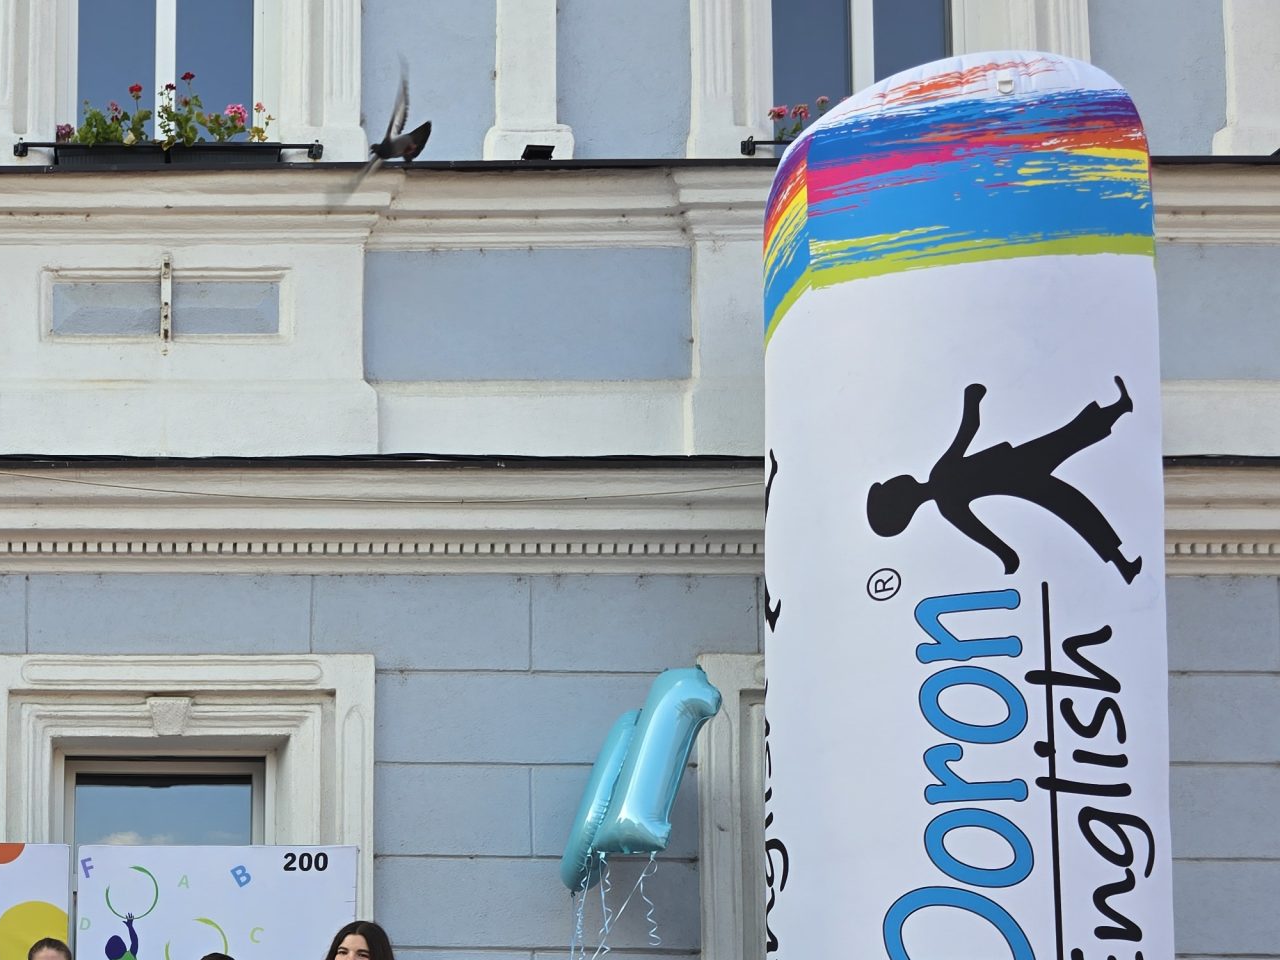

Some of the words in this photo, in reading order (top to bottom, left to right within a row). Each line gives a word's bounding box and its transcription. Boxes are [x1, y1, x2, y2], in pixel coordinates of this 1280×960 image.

[283, 852, 329, 872] 200
[177, 874, 190, 889] A
[230, 864, 252, 888] B
